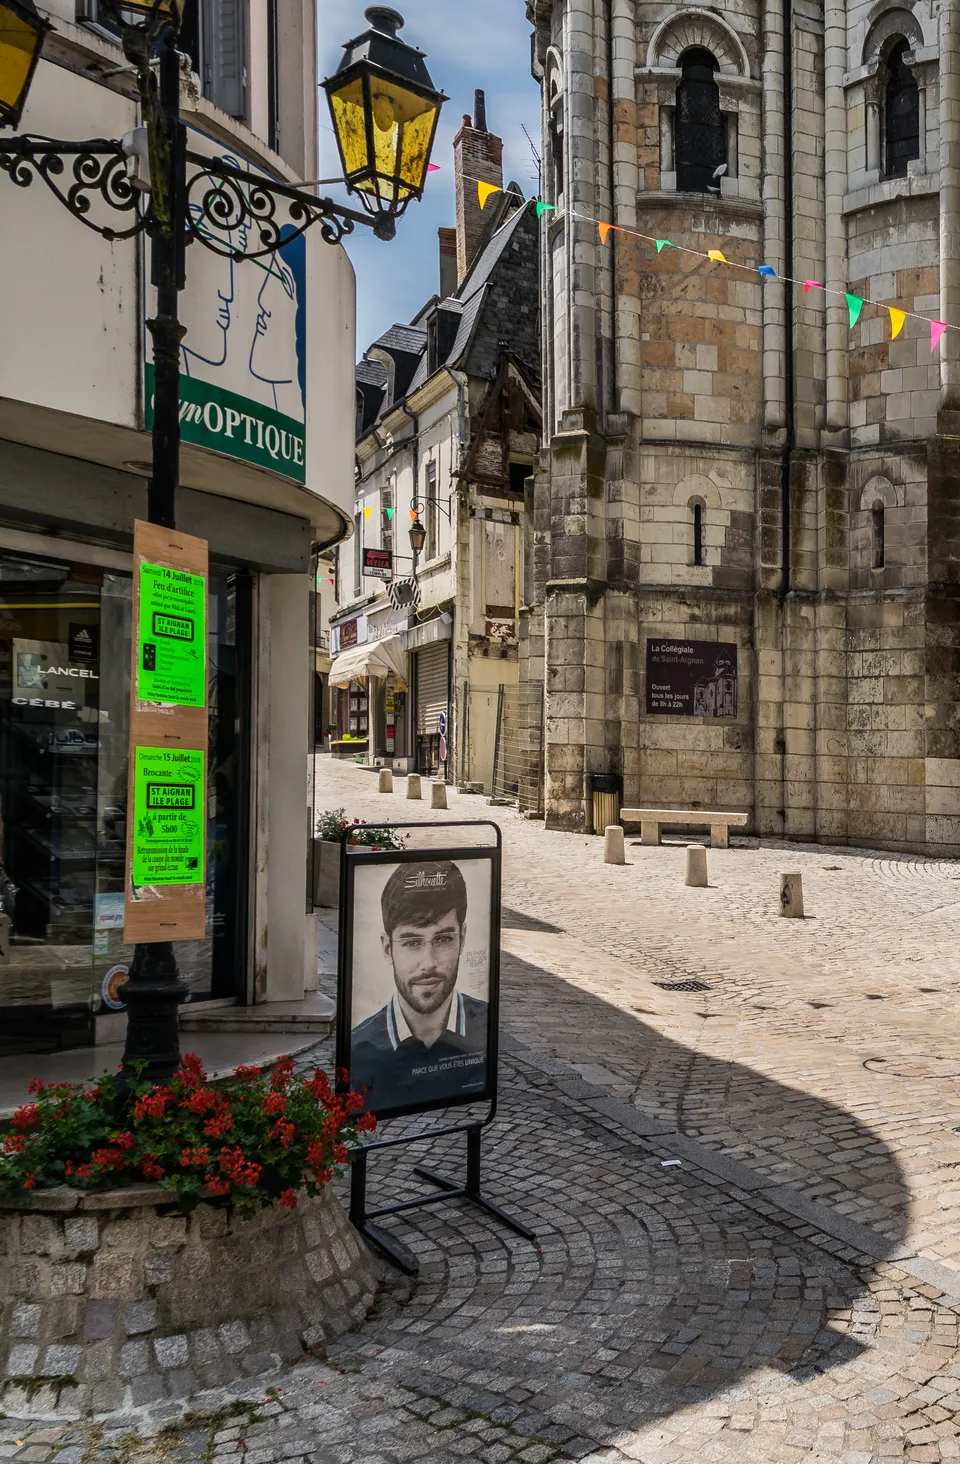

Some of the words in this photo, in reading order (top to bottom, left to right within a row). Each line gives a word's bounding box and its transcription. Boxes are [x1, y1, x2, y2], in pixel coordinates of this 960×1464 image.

[366, 558, 389, 568] WELLA
[142, 565, 161, 576] Samedi
[163, 569, 171, 579] 14
[172, 572, 193, 584] Juillet
[153, 580, 165, 591] Feu
[167, 583, 195, 597] d'artifice
[158, 617, 166, 625] ST
[167, 619, 190, 629] AIGNAN
[159, 625, 168, 633] ILE
[170, 627, 189, 637] PLAGE
[661, 644, 694, 655] Collégiale
[661, 655, 704, 665] Saint-Aignan
[37, 664, 99, 679] LANCEL
[651, 683, 671, 691] Ouvert
[674, 693, 689, 701] jours
[139, 753, 162, 761] Dimanche
[163, 753, 170, 762] 15
[171, 754, 191, 762] Juillet
[143, 768, 173, 777] Brocante
[162, 788, 191, 796] AIGNAN
[153, 797, 164, 805] ILE
[153, 812, 157, 821] à
[158, 812, 177, 823] partir
[178, 812, 186, 821] de
[161, 825, 178, 833] 5h00
[168, 845, 173, 853] de
[142, 855, 147, 863] de
[152, 856, 164, 865] coupe
[165, 854, 170, 862] du
[171, 854, 184, 862] monde
[155, 863, 166, 874] grand
[404, 871, 447, 888] Silhouette
[411, 1066, 428, 1076] PARCE
[428, 1065, 438, 1073] QUE
[439, 1062, 453, 1070] VOUS
[453, 1060, 464, 1068] ÊTES
[464, 1056, 484, 1066] UNIQUE
